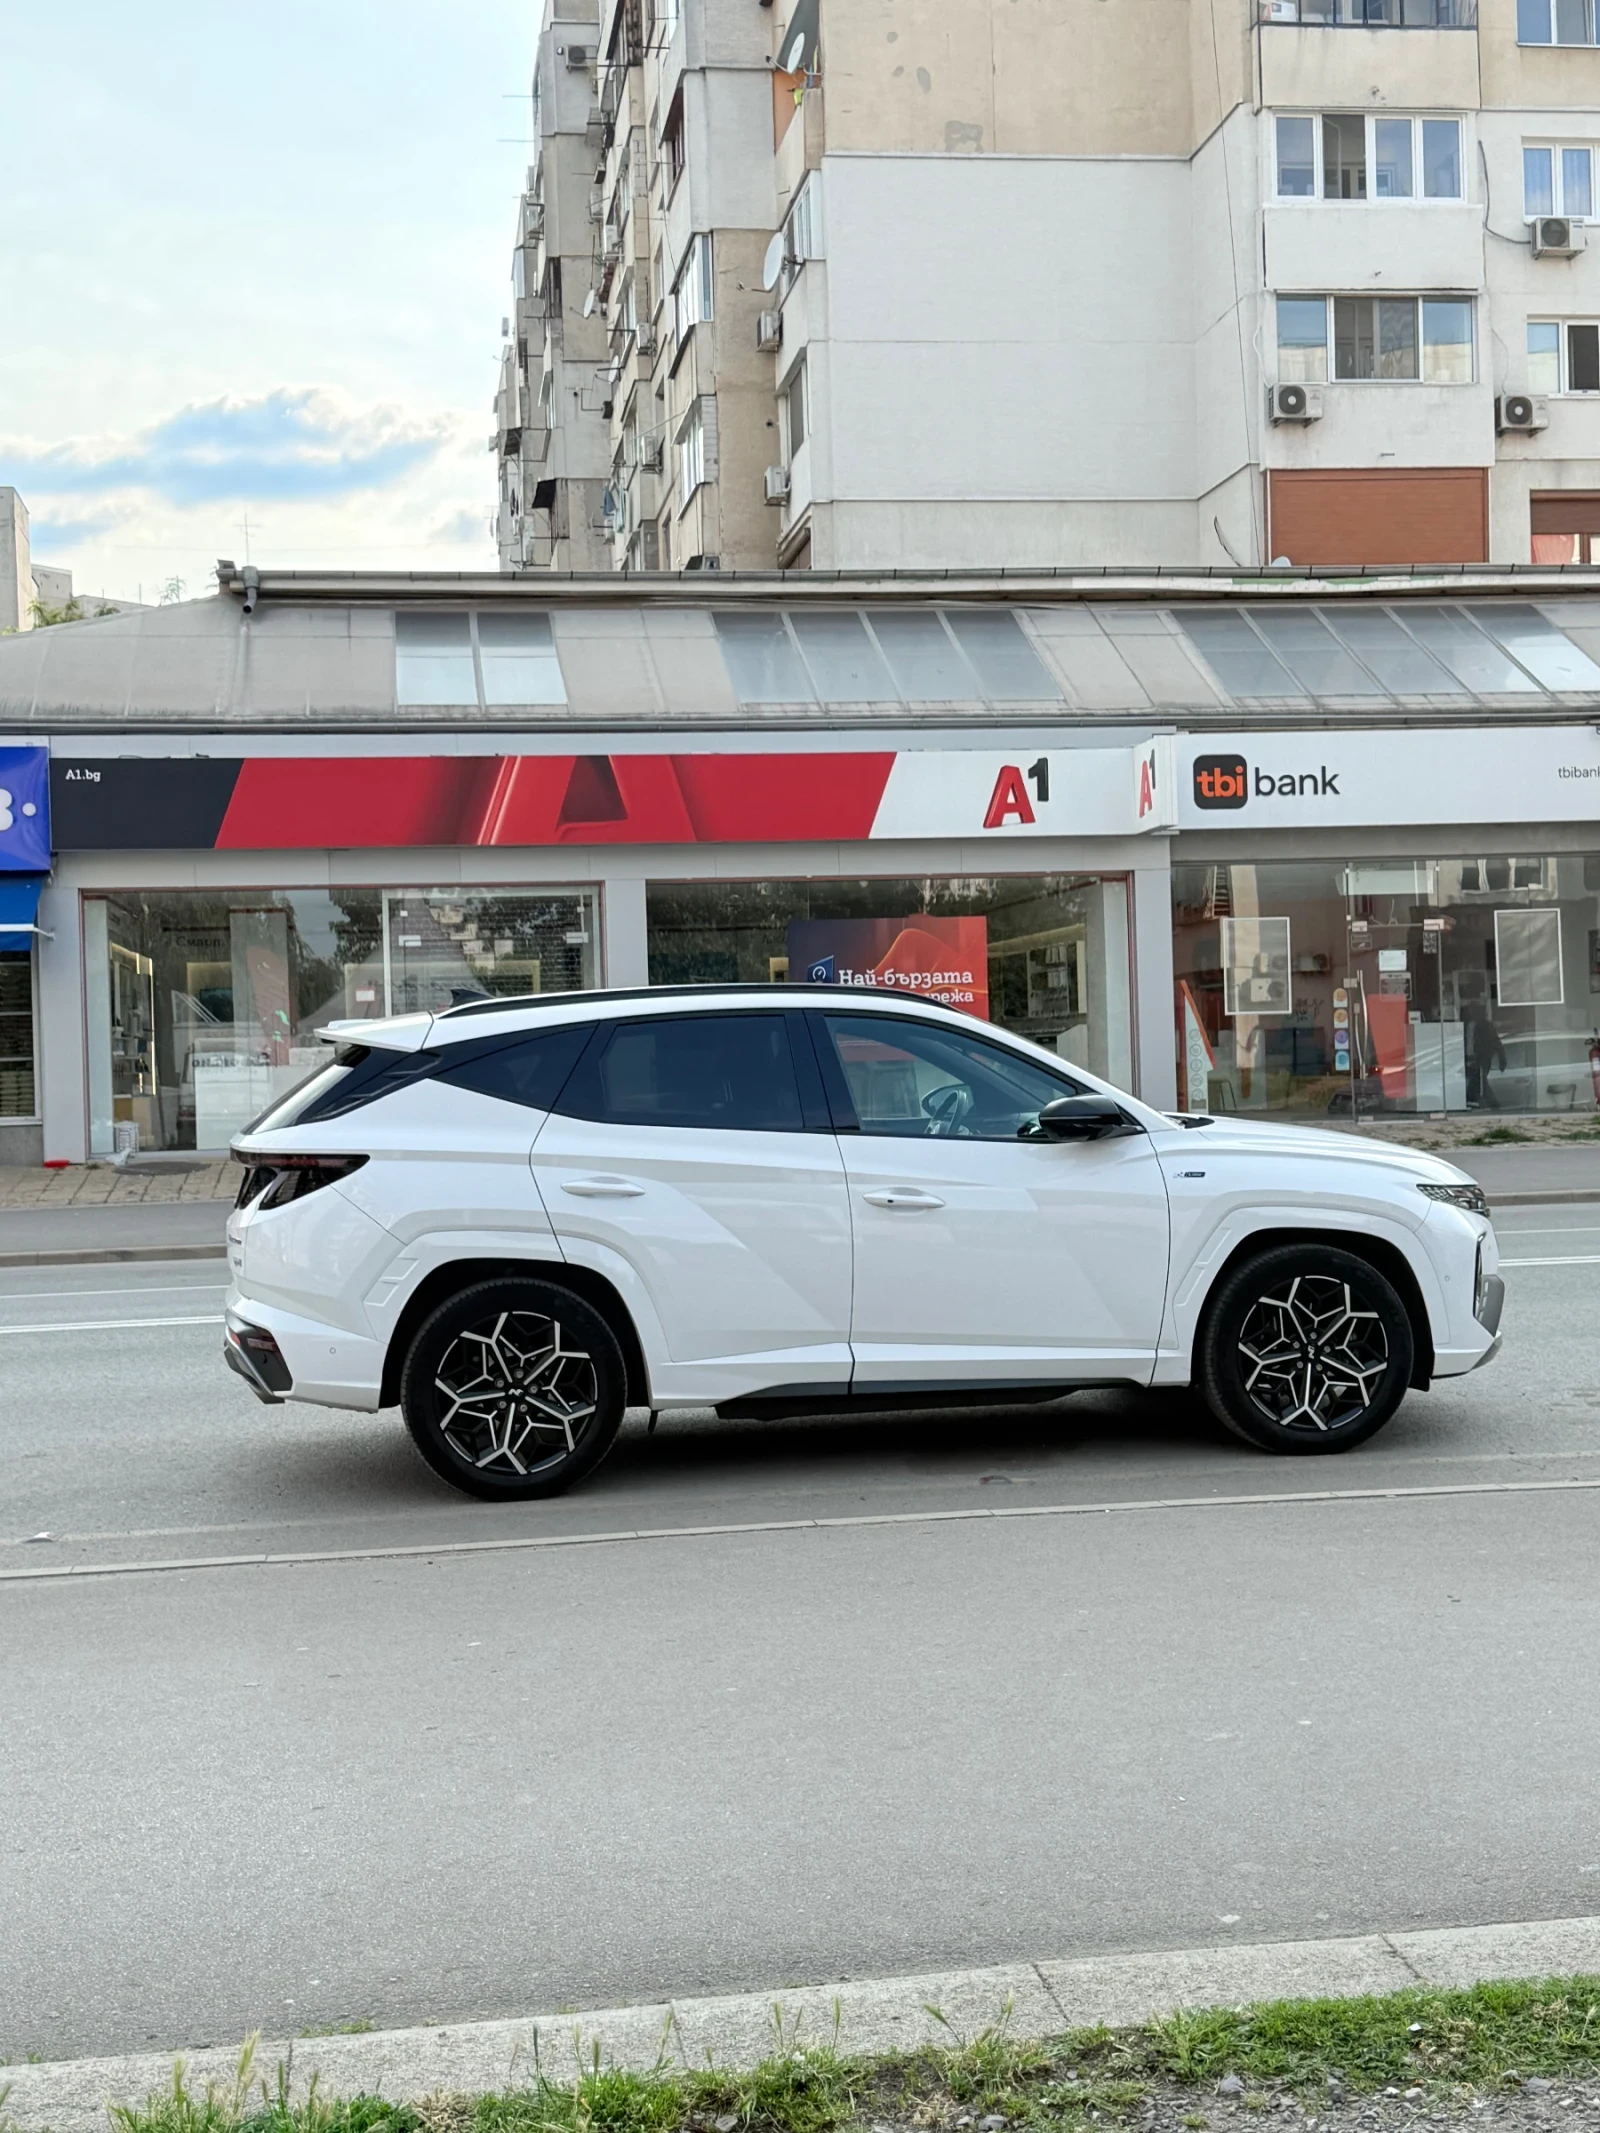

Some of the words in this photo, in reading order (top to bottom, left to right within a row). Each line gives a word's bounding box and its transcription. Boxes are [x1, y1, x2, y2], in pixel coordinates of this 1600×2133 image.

[65, 769, 102, 783] A1.bg
[1139, 748, 1156, 818] A1
[1196, 765, 1244, 797] tbi
[1254, 766, 1341, 797] bank
[983, 757, 1050, 829] A1
[838, 968, 974, 989] Най-бързата
